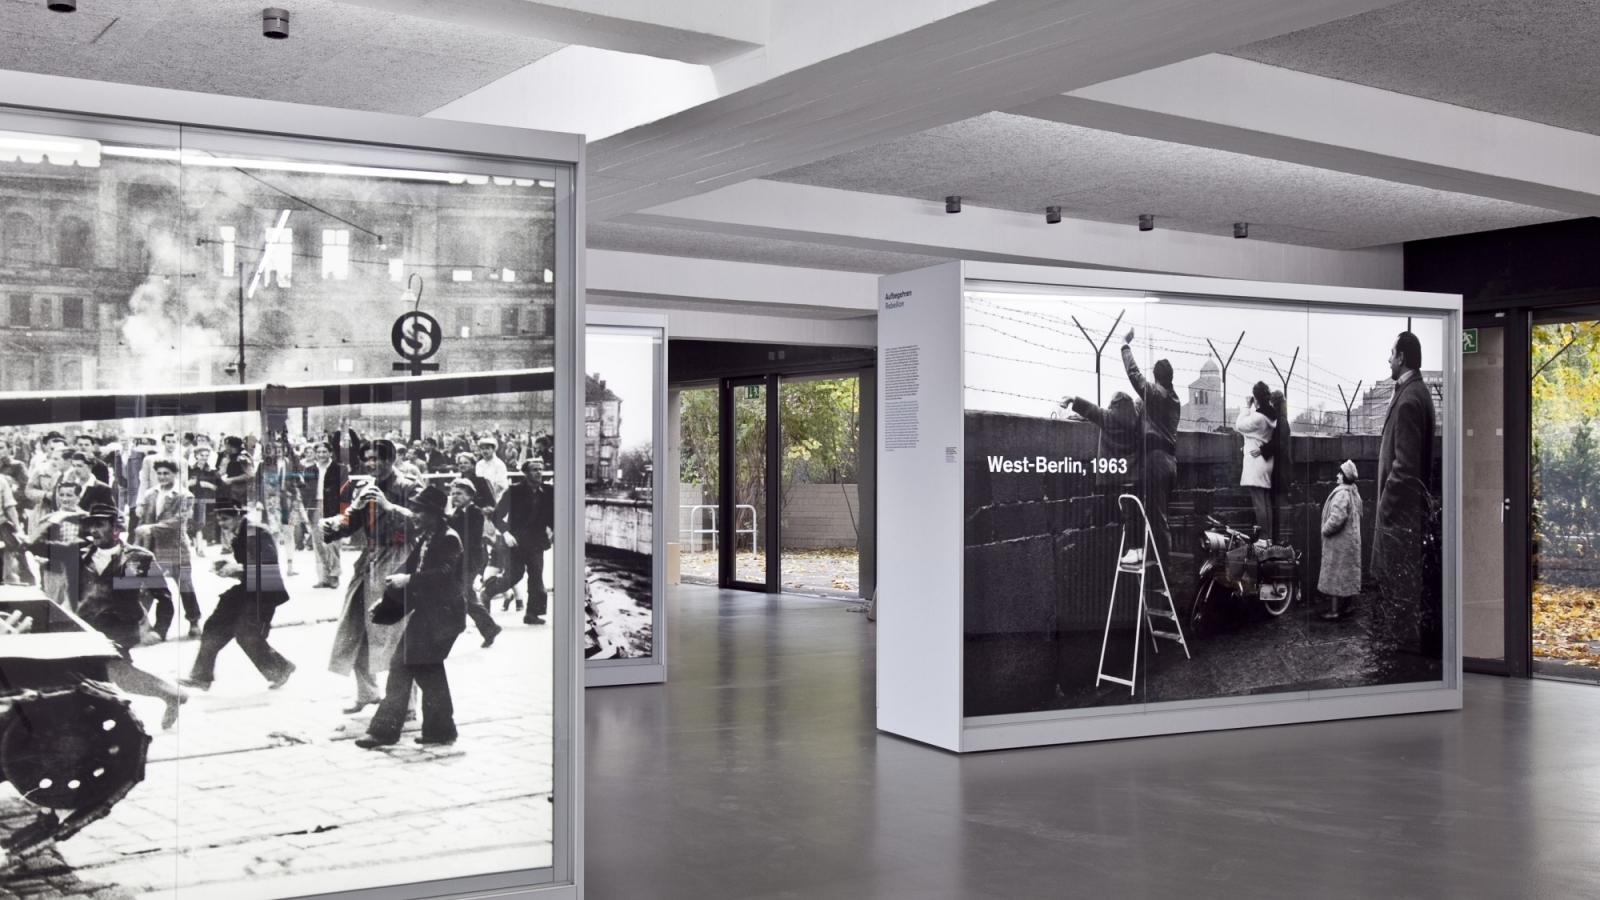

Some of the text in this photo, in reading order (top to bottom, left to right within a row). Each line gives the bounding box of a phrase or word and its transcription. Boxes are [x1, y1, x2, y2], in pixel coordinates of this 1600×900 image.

[885, 290, 912, 300] Aufbegehren
[885, 301, 904, 309] Rebellion
[401, 315, 432, 356] S
[987, 455, 1128, 476] West-Berlin, 1963
